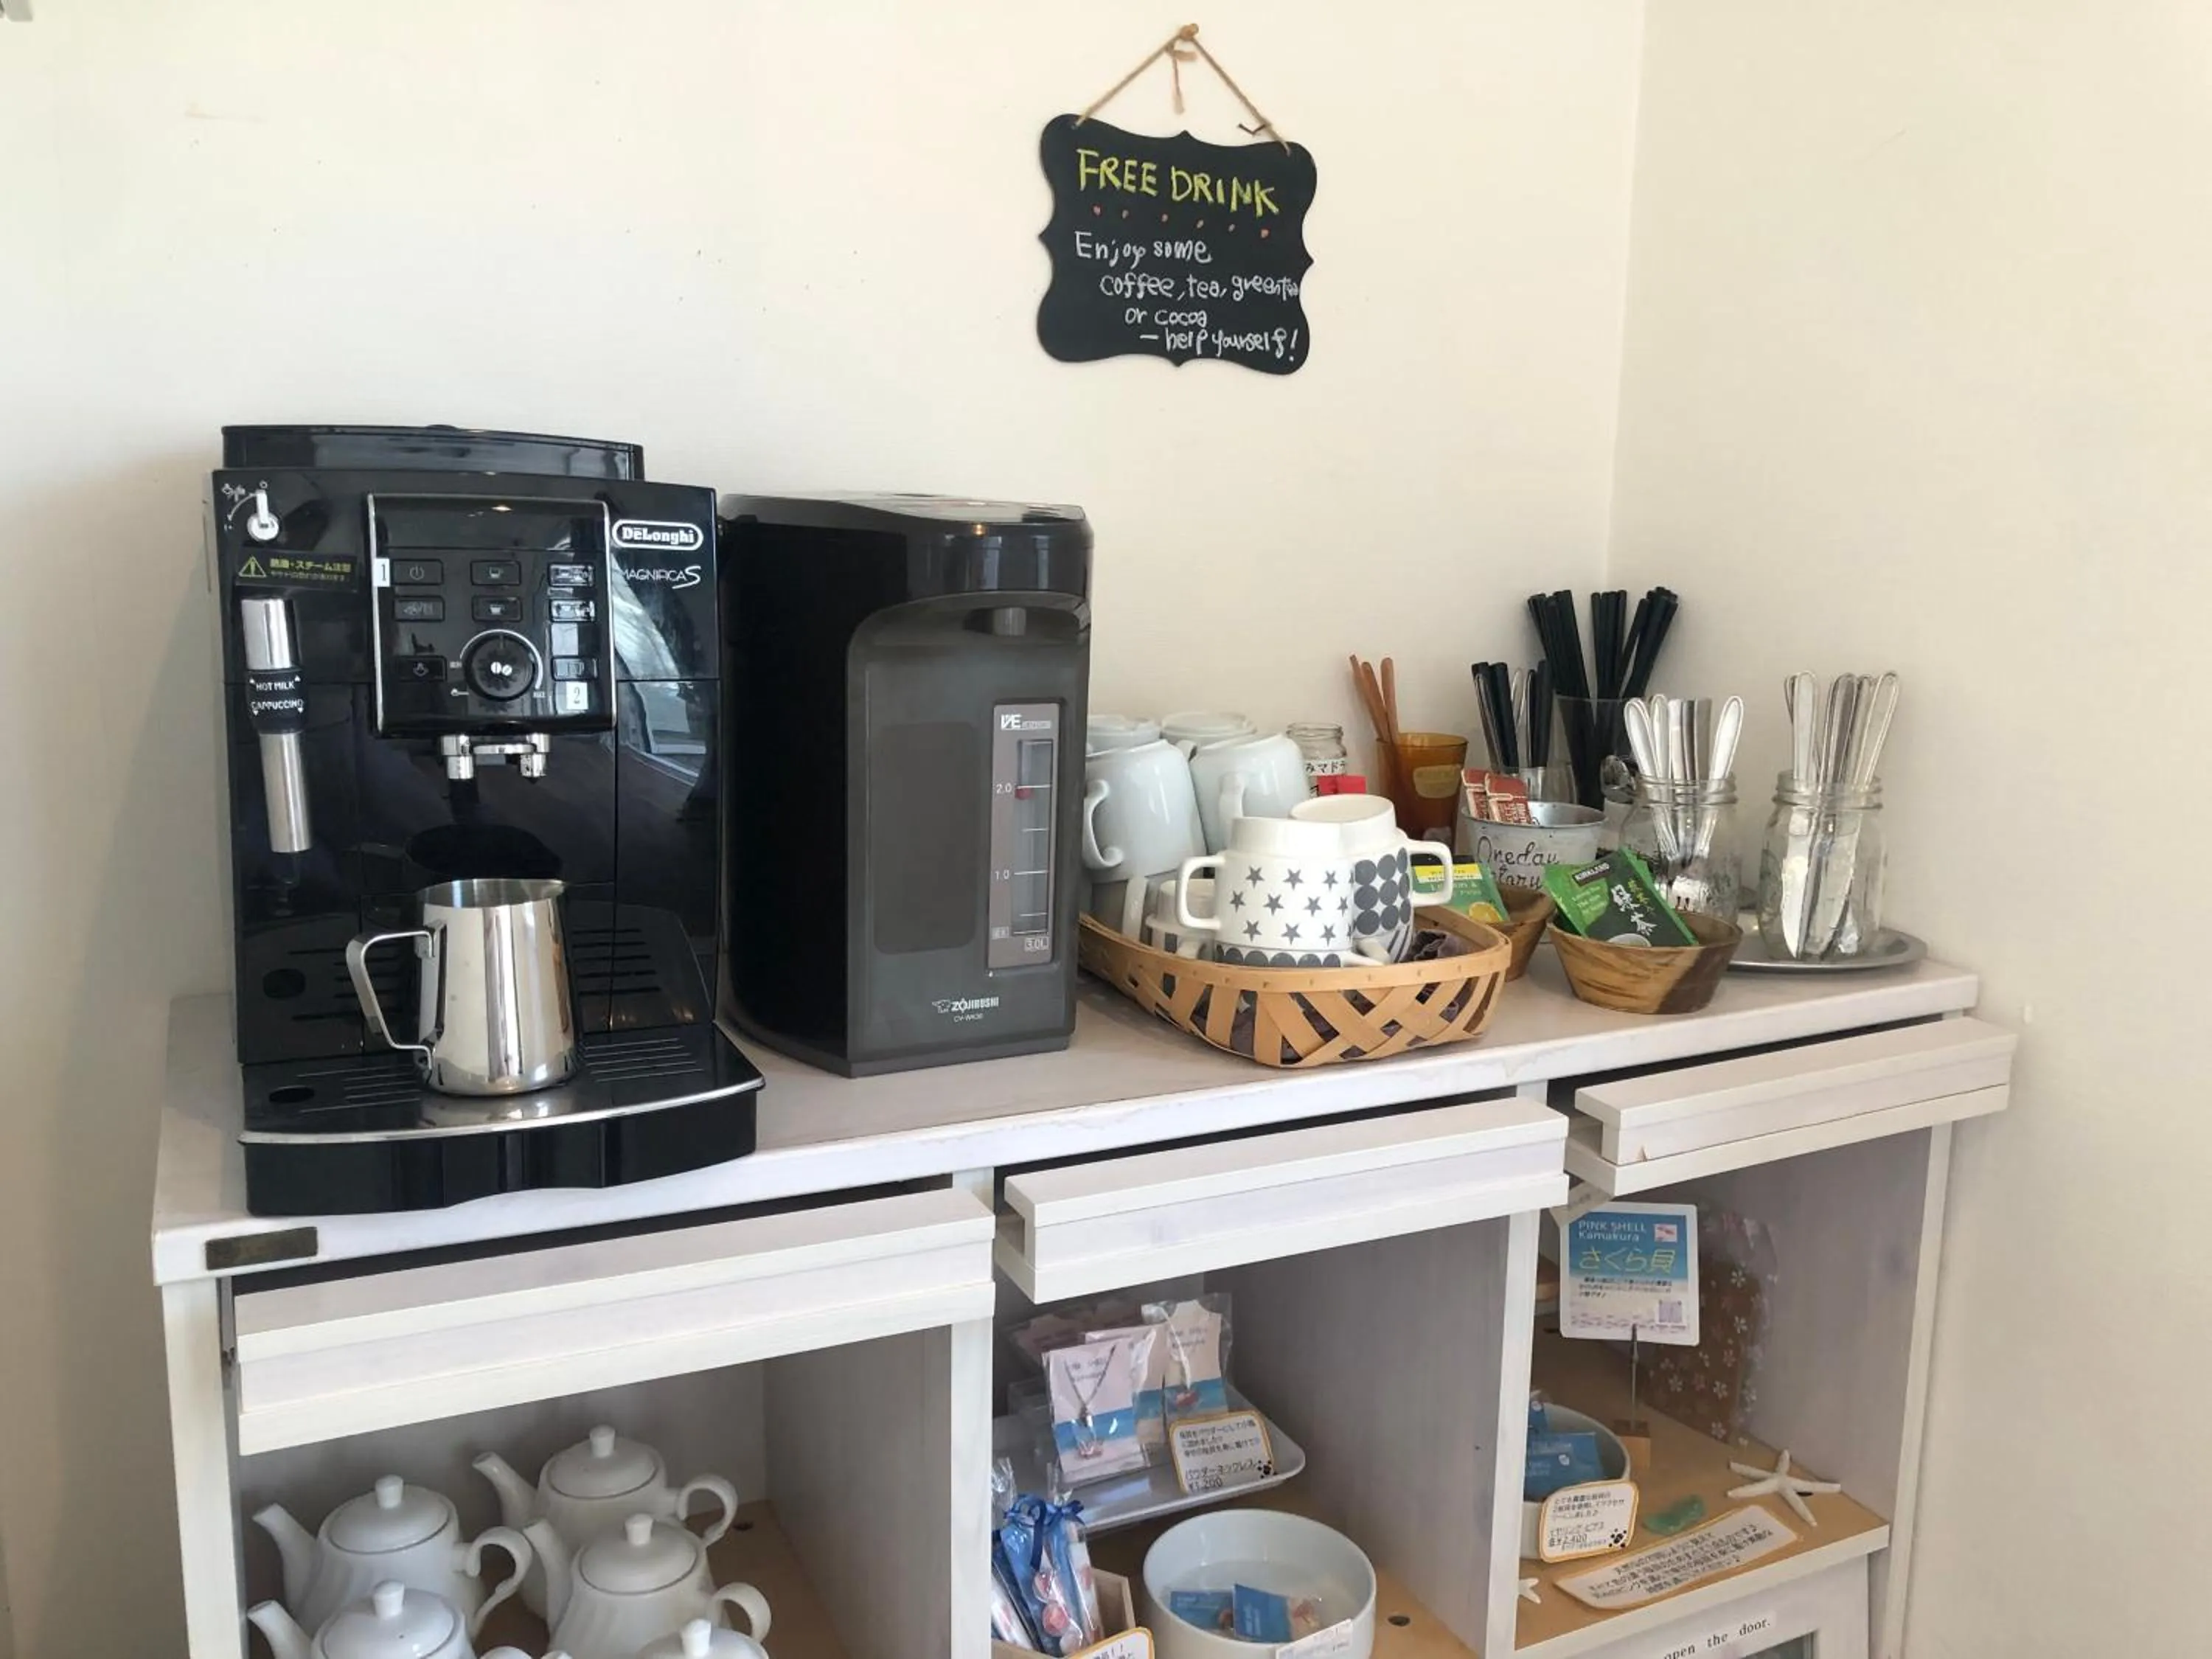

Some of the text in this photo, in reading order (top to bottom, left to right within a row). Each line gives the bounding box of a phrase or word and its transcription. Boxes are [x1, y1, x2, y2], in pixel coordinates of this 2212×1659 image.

[1077, 148, 1280, 218] FREE DRINK
[1074, 231, 1213, 269] Enjoy some
[1124, 307, 1208, 328] or cocoa
[1164, 327, 1208, 355] help
[1211, 327, 1298, 362] yourself!
[380, 563, 387, 582] 1
[256, 680, 295, 692] HOT MILK
[572, 686, 581, 705] 2
[251, 698, 304, 711] CAPPUCCINO
[995, 783, 1012, 794] 2.0
[995, 869, 1009, 880] 1.0
[1491, 863, 1544, 891] tory
[1573, 861, 1610, 881] KIRKLAND
[1578, 1220, 1647, 1234] PINK SHELL
[1579, 1231, 1641, 1242] Kamakura
[1579, 1244, 1677, 1275] さくら貝
[1663, 1618, 1771, 1659] open the door.
